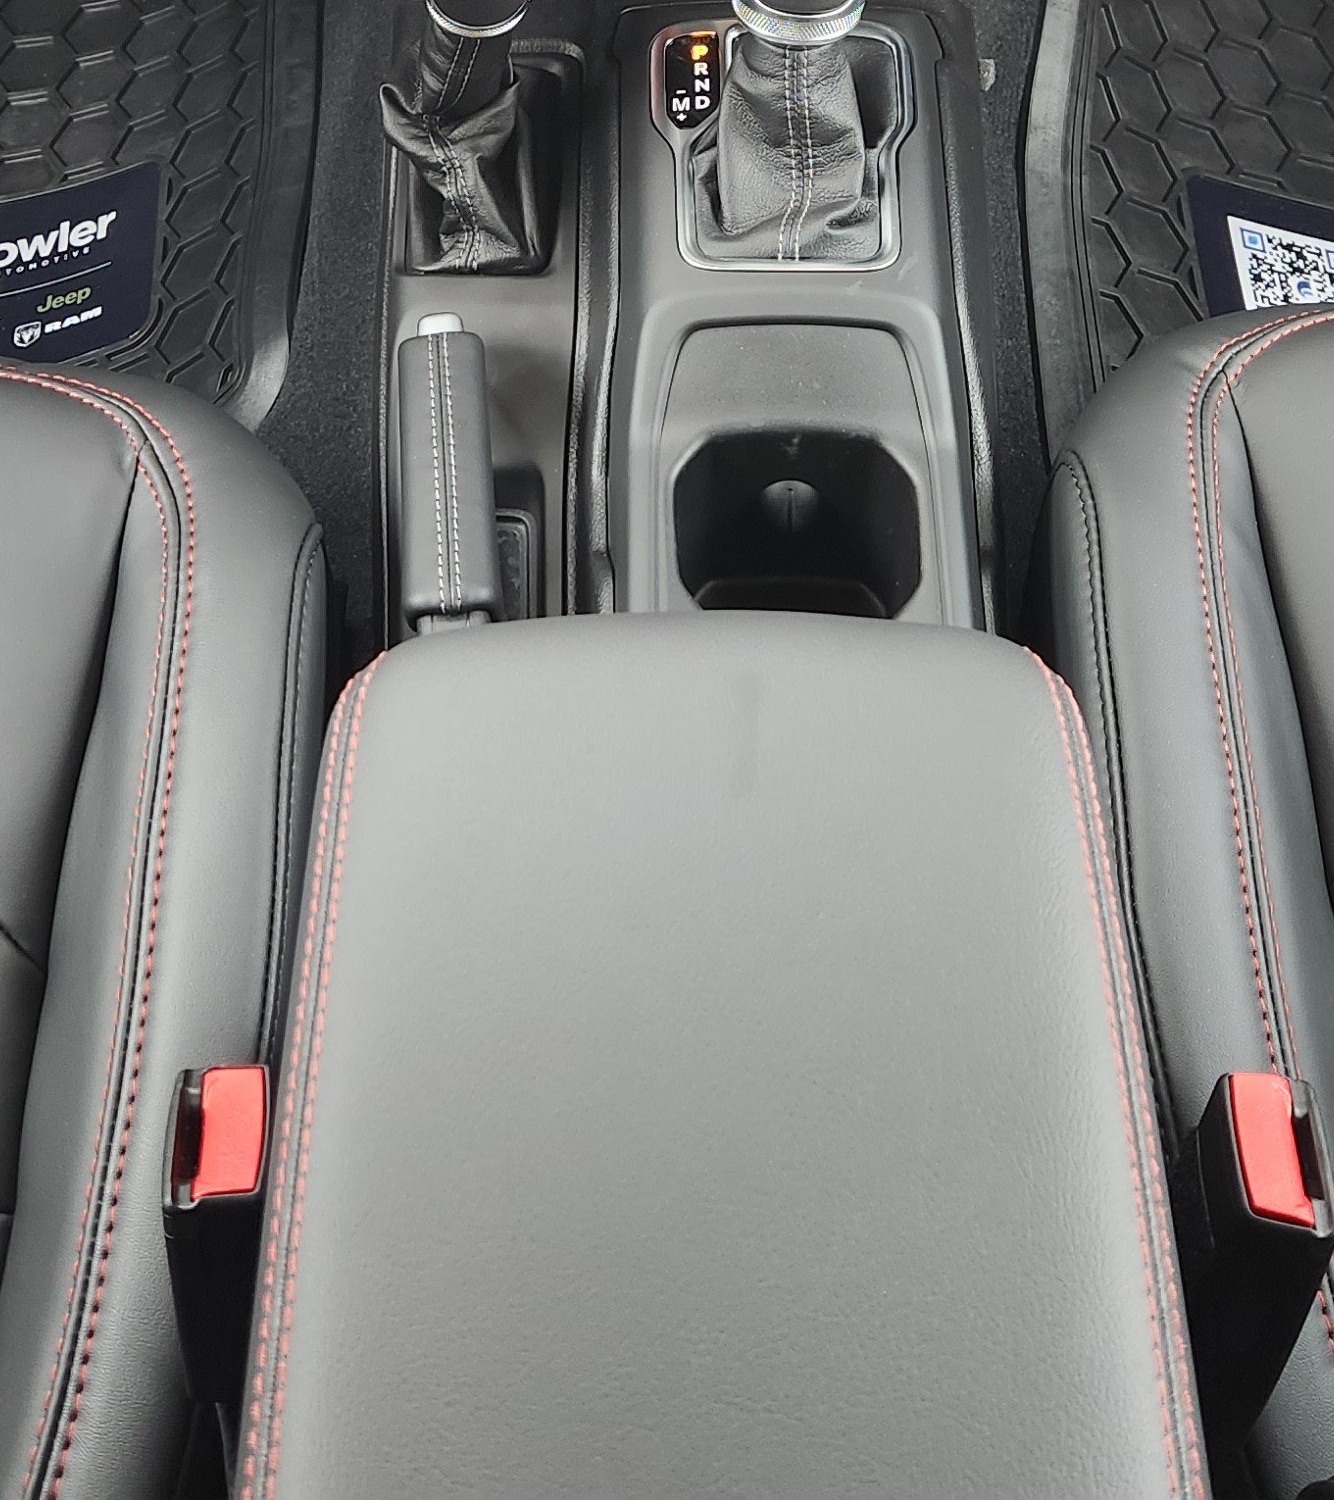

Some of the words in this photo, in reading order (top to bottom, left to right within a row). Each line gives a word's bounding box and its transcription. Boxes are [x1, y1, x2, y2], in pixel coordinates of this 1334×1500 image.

[691, 44, 709, 60] P
[694, 62, 709, 76] R
[694, 78, 710, 93] N
[672, 97, 691, 111] M
[695, 95, 711, 110] D
[37, 286, 91, 313] Jeep
[45, 306, 104, 334] RAM
